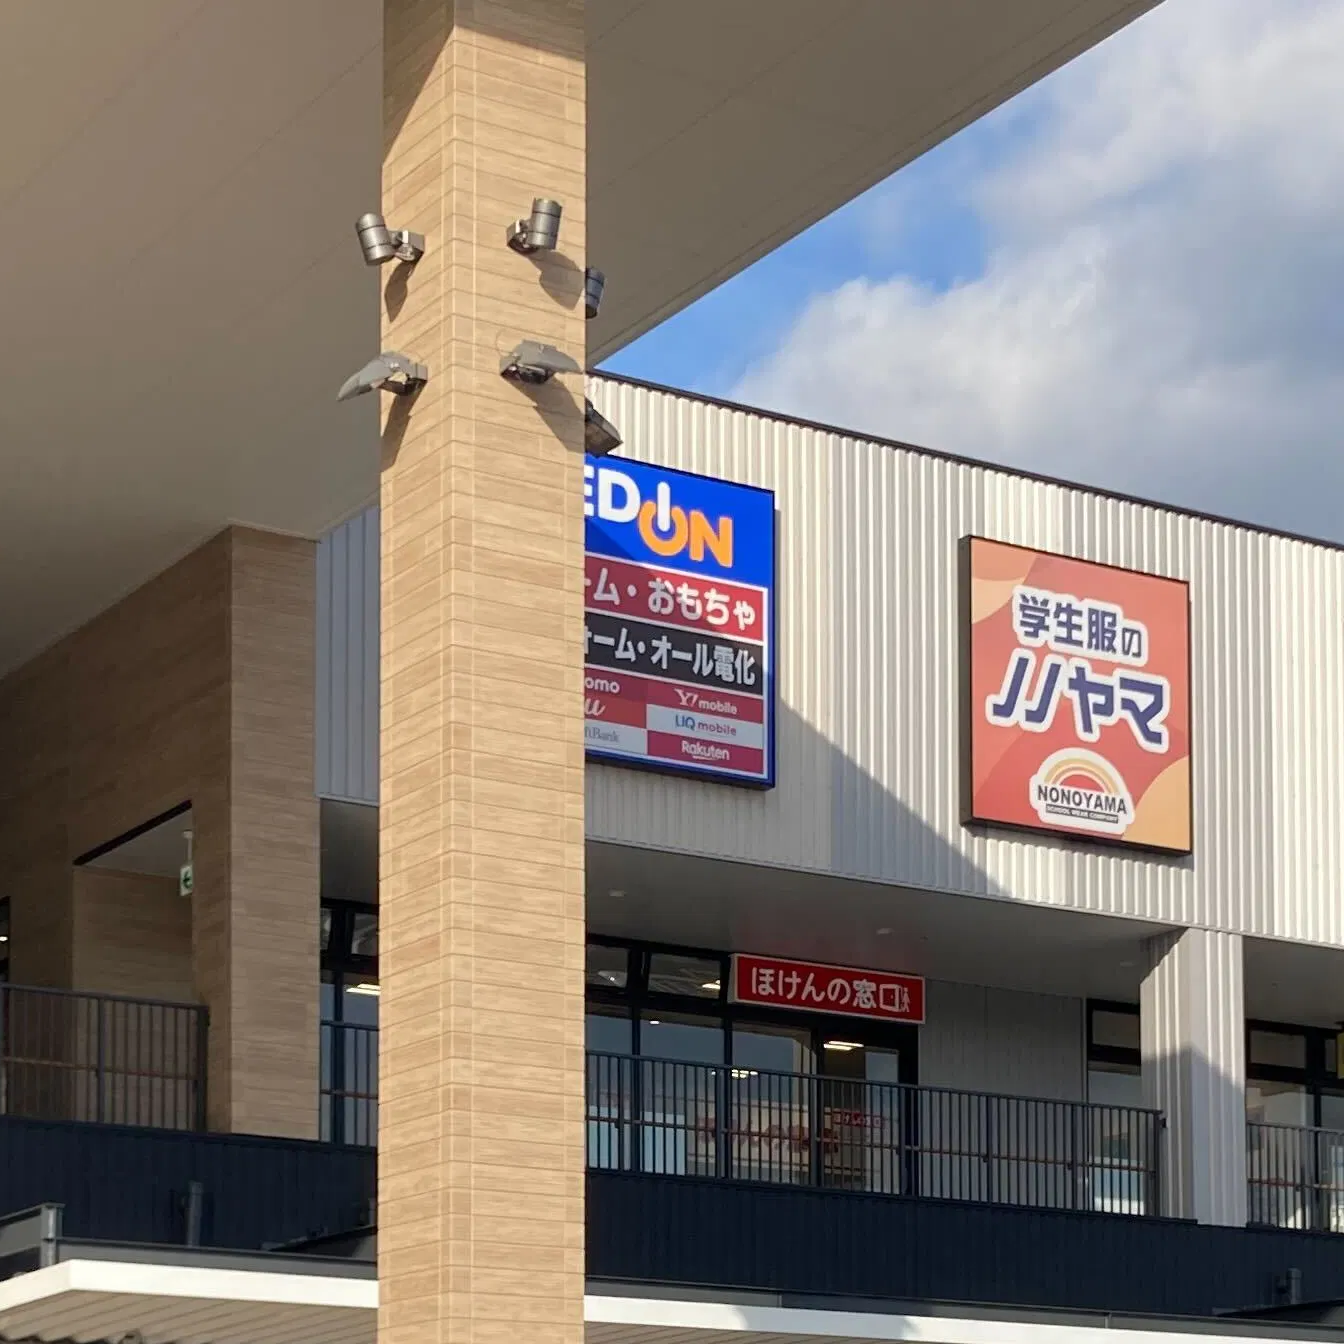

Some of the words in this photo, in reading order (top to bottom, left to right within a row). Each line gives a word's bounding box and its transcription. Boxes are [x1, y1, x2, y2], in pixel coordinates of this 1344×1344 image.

[584, 568, 756, 631] ム・おもちゃ
[1019, 594, 1143, 658] 学生服の
[699, 699, 738, 715] mobile
[992, 656, 1165, 746] ノノヤマ
[697, 722, 737, 737] mobile
[681, 740, 730, 760] Rakuten
[1037, 784, 1128, 815] NONOYAMA
[751, 966, 905, 1013] ほけんの窓口
